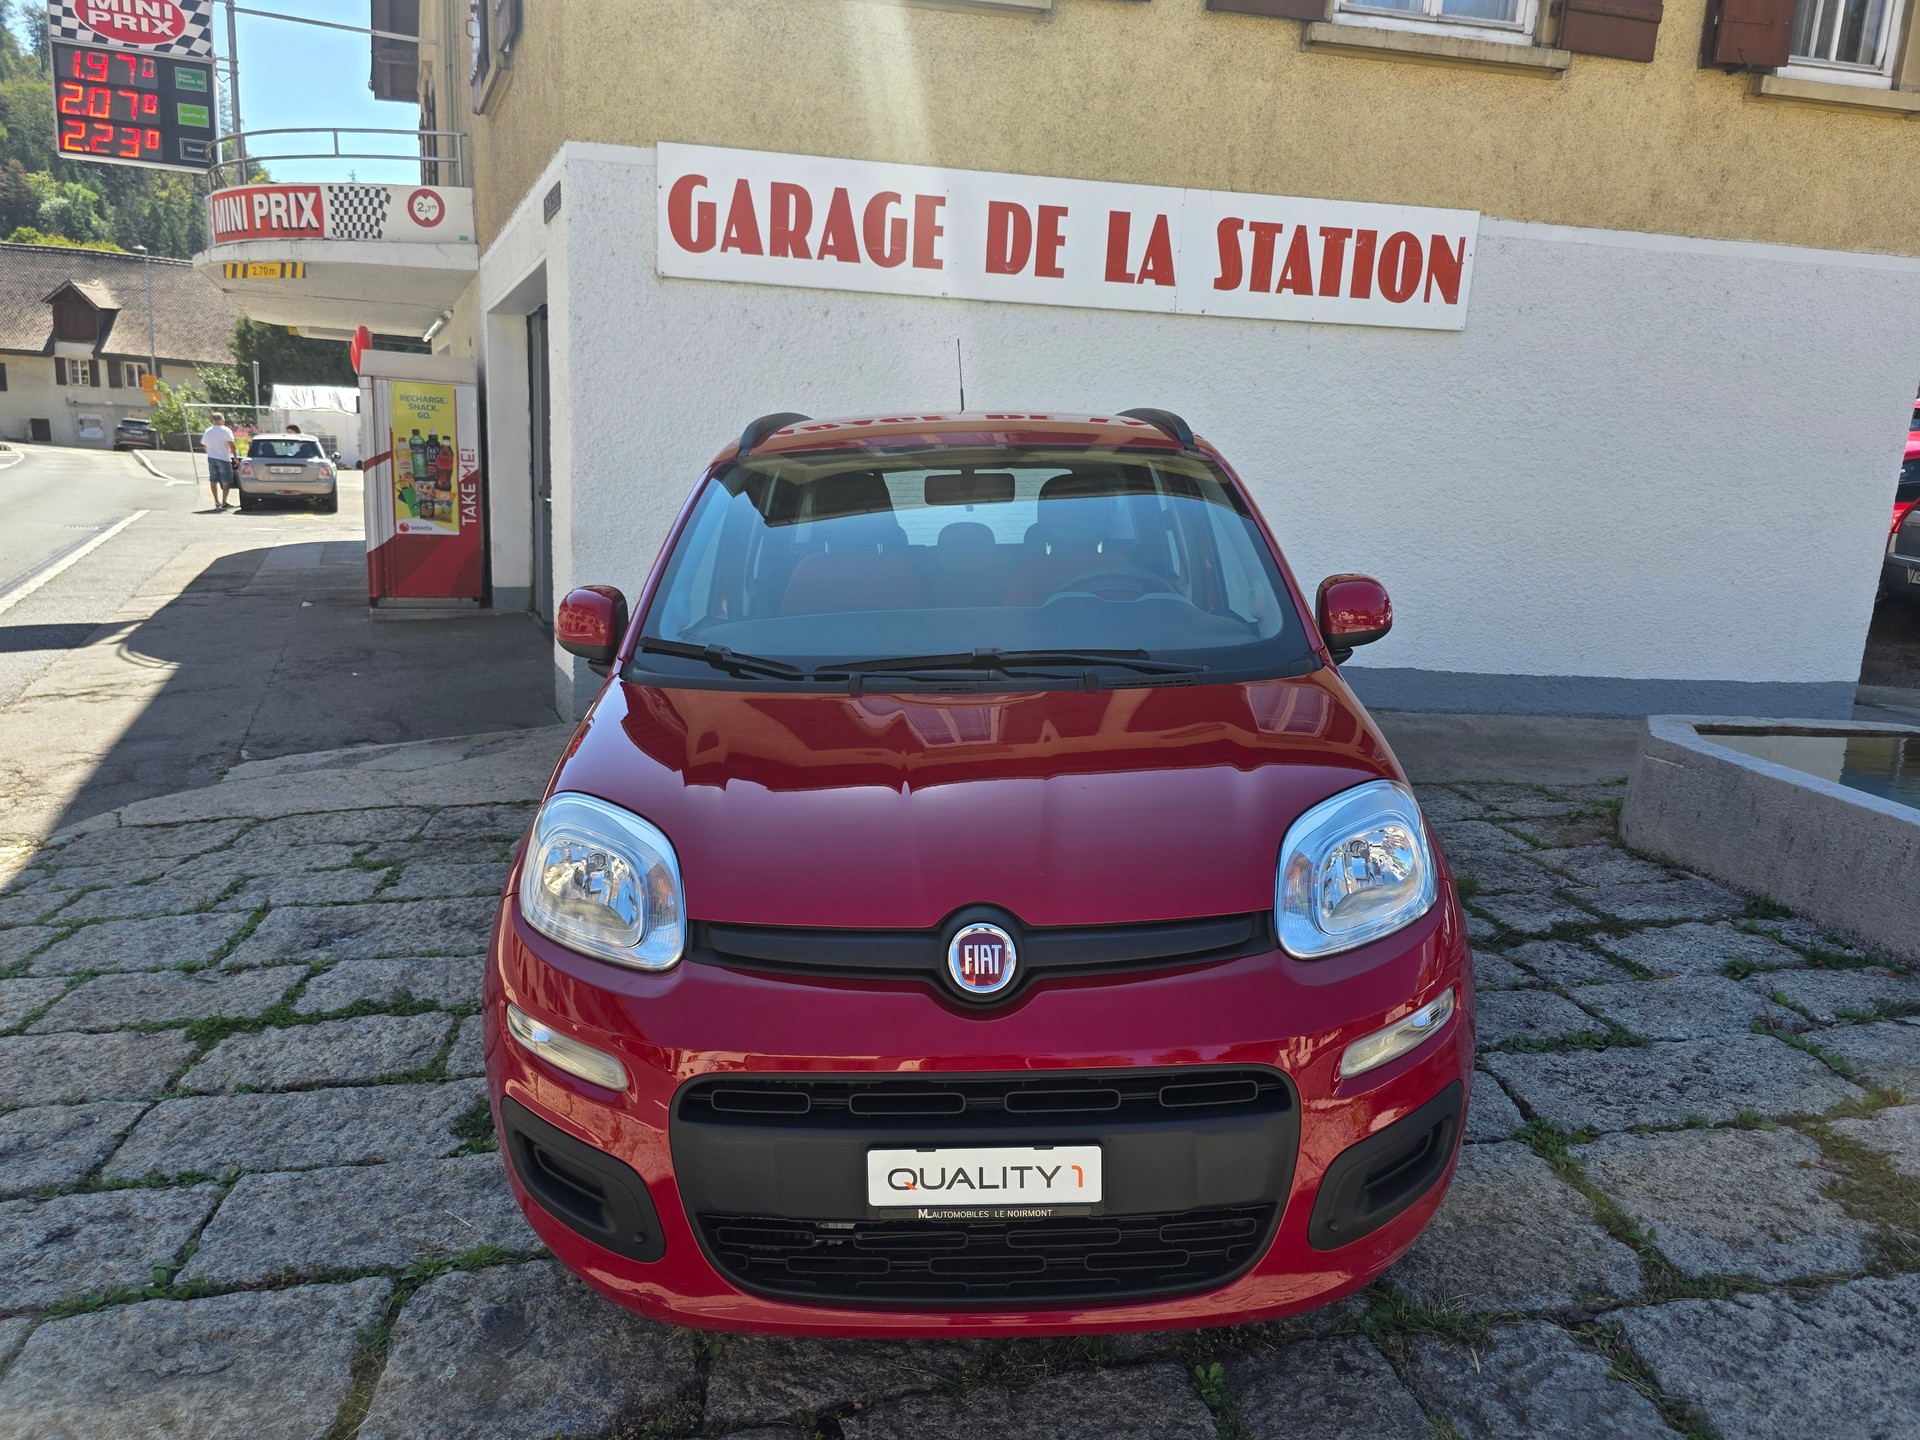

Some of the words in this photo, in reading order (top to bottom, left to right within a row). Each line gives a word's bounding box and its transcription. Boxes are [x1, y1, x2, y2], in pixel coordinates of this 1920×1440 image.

[87, 9, 176, 37] PRIX
[214, 195, 249, 234] MINI
[253, 192, 320, 229] PRIX
[667, 173, 947, 270] GARAGE
[985, 200, 1069, 279] DE
[1105, 210, 1176, 287] LA
[1213, 216, 1467, 305] STATION
[252, 266, 277, 276] 2.70m
[400, 394, 448, 405] RECHARGE.
[408, 403, 440, 412] SNACK.
[417, 411, 432, 420] GO.
[461, 448, 475, 479] ME!
[461, 483, 477, 526] TAKE
[964, 944, 1003, 975] FIAT
[887, 1165, 1062, 1191] QUALITY
[994, 1209, 1005, 1218] LE
[1007, 1209, 1053, 1218] NOIRMONT
